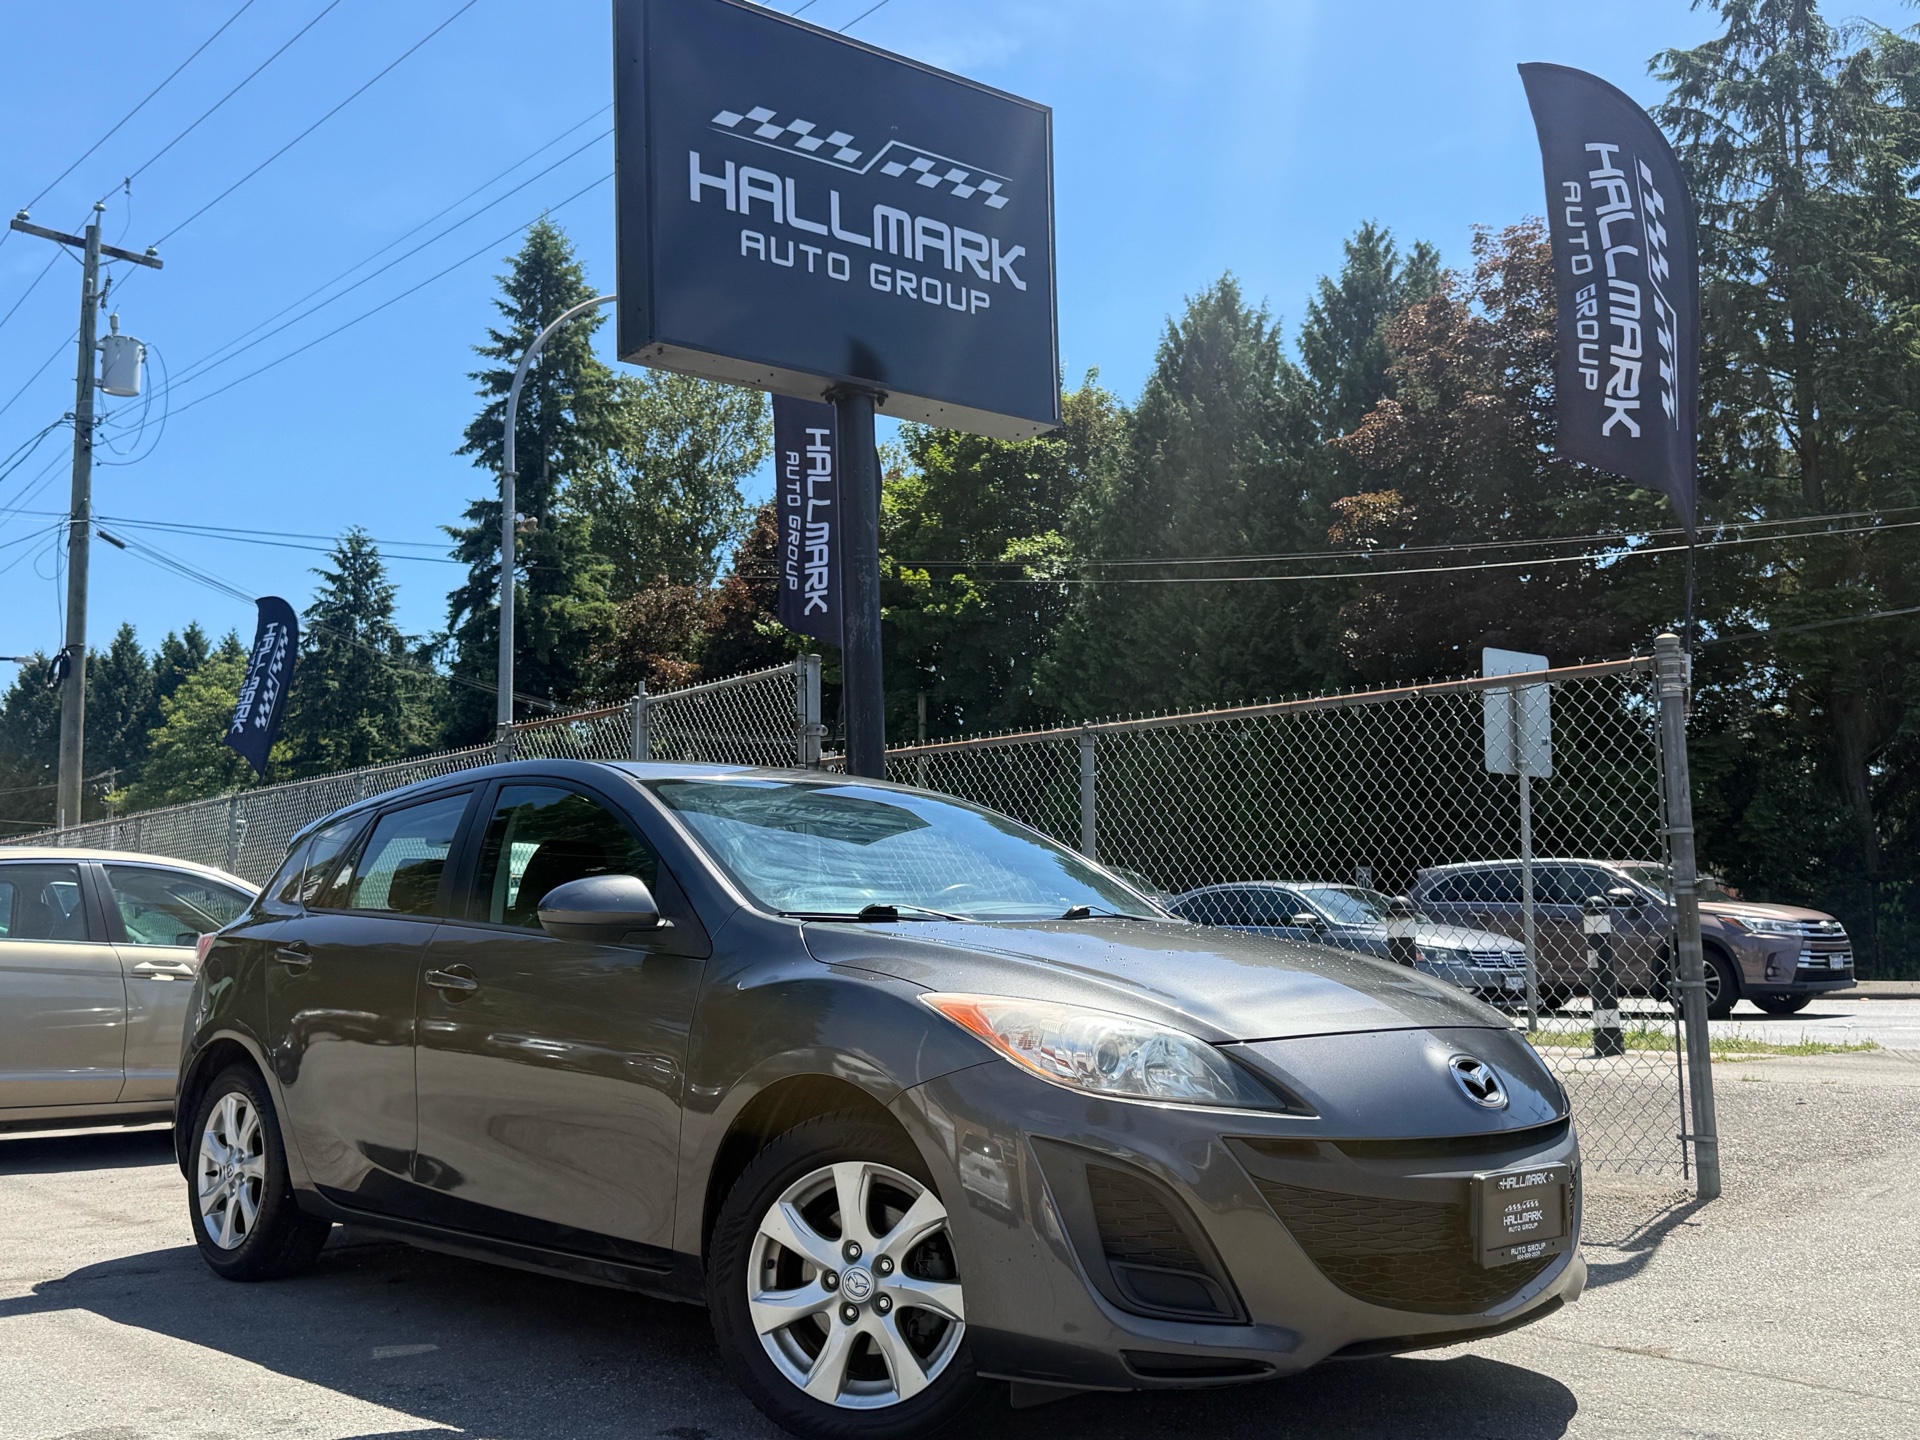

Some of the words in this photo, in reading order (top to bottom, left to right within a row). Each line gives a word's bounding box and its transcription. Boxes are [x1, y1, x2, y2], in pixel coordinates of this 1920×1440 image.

[689, 150, 1026, 291] HALLMARK
[1562, 181, 1594, 276] AUTO
[740, 229, 850, 282] AUTO
[870, 262, 991, 315] GROUP
[1585, 142, 1643, 438] HALLMARK
[1575, 283, 1600, 391] GROUP
[786, 451, 802, 507] AUTO
[804, 428, 832, 616] HALLMARK
[785, 515, 801, 591] GROUP
[231, 622, 279, 734] HALLMARK
[1502, 1172, 1547, 1189] HALLMARK
[1503, 1210, 1542, 1226] HALLMARK
[1508, 1225, 1521, 1233] AUTO
[1521, 1222, 1538, 1231] GROUP
[1510, 1246, 1526, 1255] AUTO
[1527, 1242, 1546, 1252] GROUP
